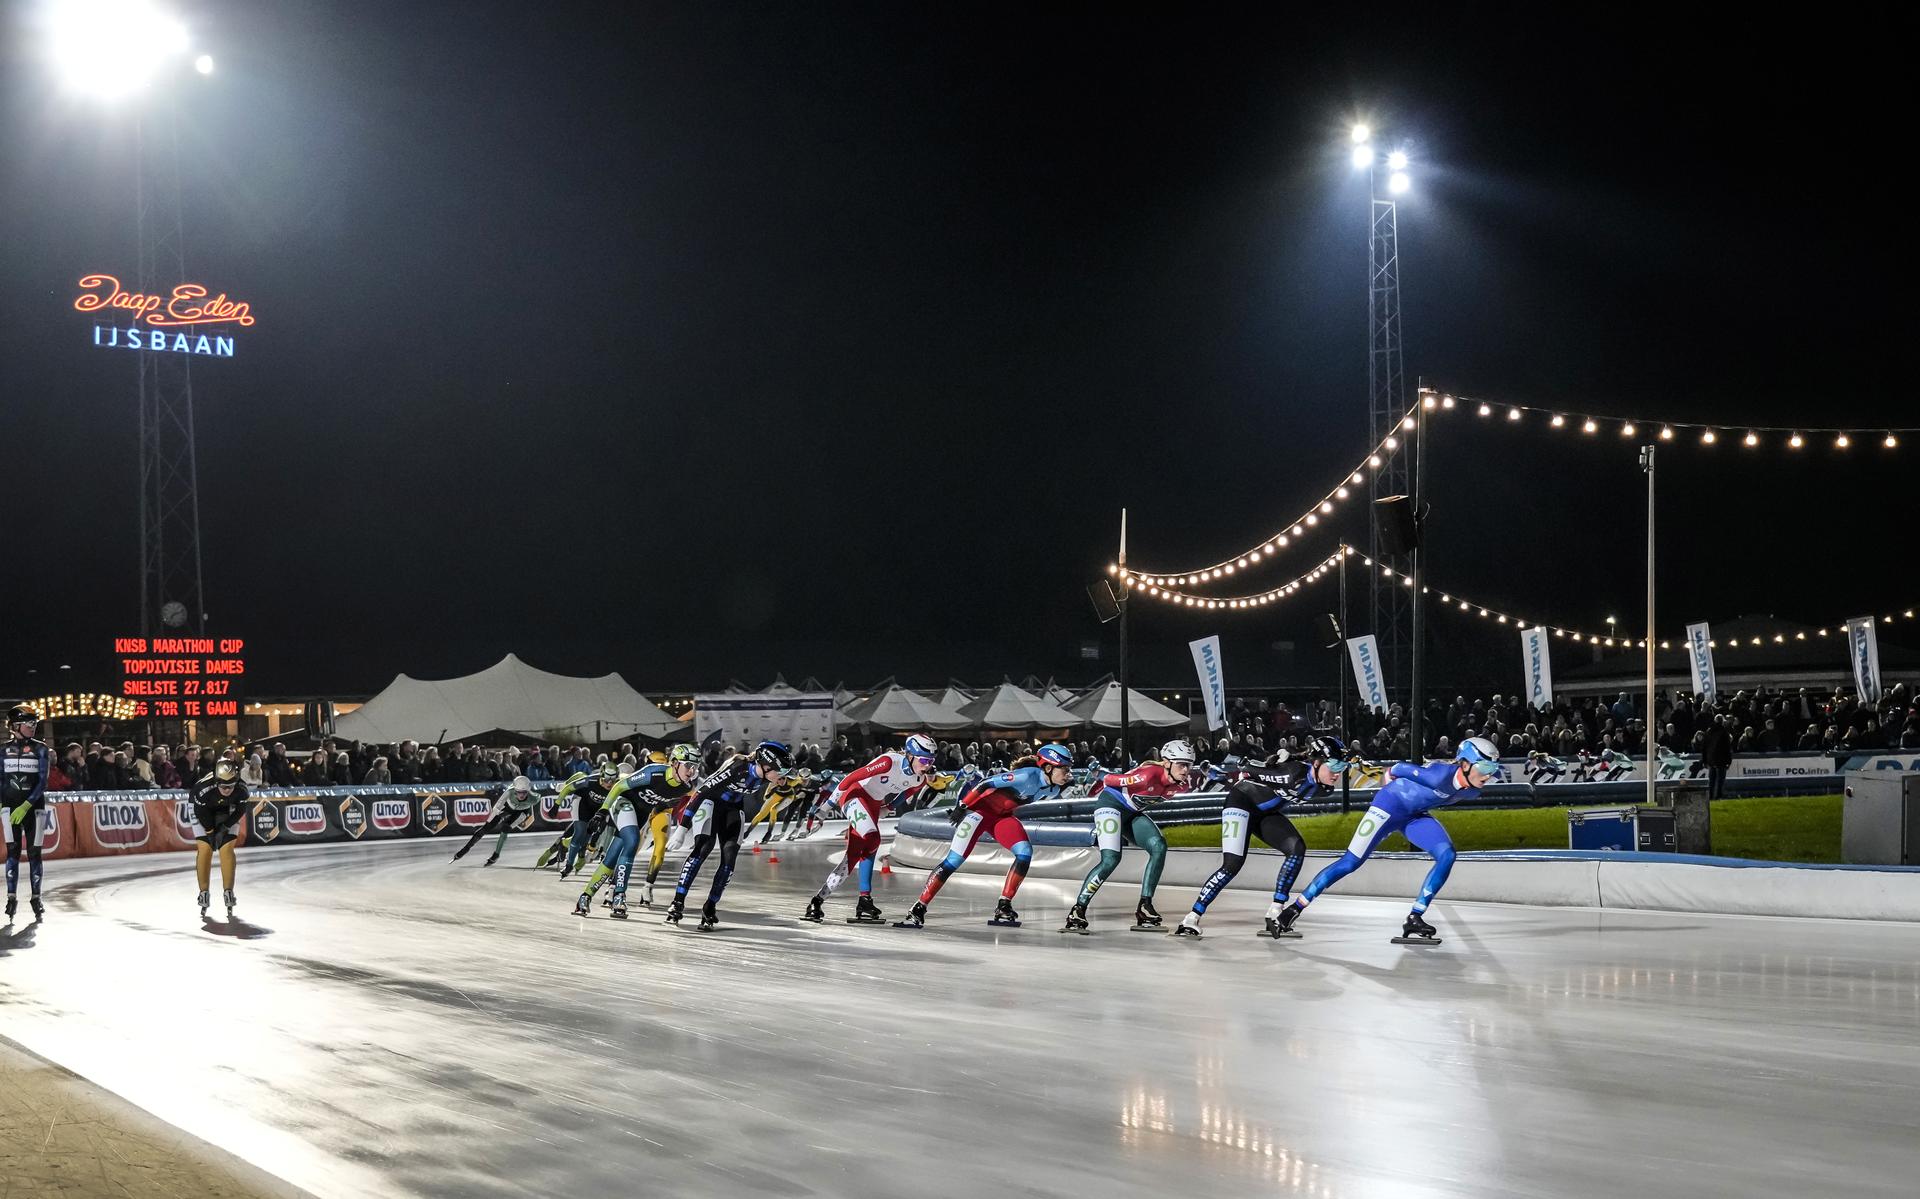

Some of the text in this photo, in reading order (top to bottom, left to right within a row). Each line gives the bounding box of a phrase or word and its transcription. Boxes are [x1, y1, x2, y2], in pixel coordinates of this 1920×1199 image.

[75, 275, 254, 326] Jaap Eden
[93, 326, 234, 356] IJSBAAN
[115, 638, 243, 654] KNSB MARATHON CUP
[123, 660, 244, 675] TOPDIVISIE DAMES
[123, 681, 229, 695] SNELSTE 27.817
[184, 702, 200, 716] TE
[206, 701, 237, 716] GAAN
[705, 769, 732, 788] PALET
[1259, 774, 1290, 784] PALET
[617, 865, 627, 888] OCRE
[1200, 871, 1226, 901] PALET
